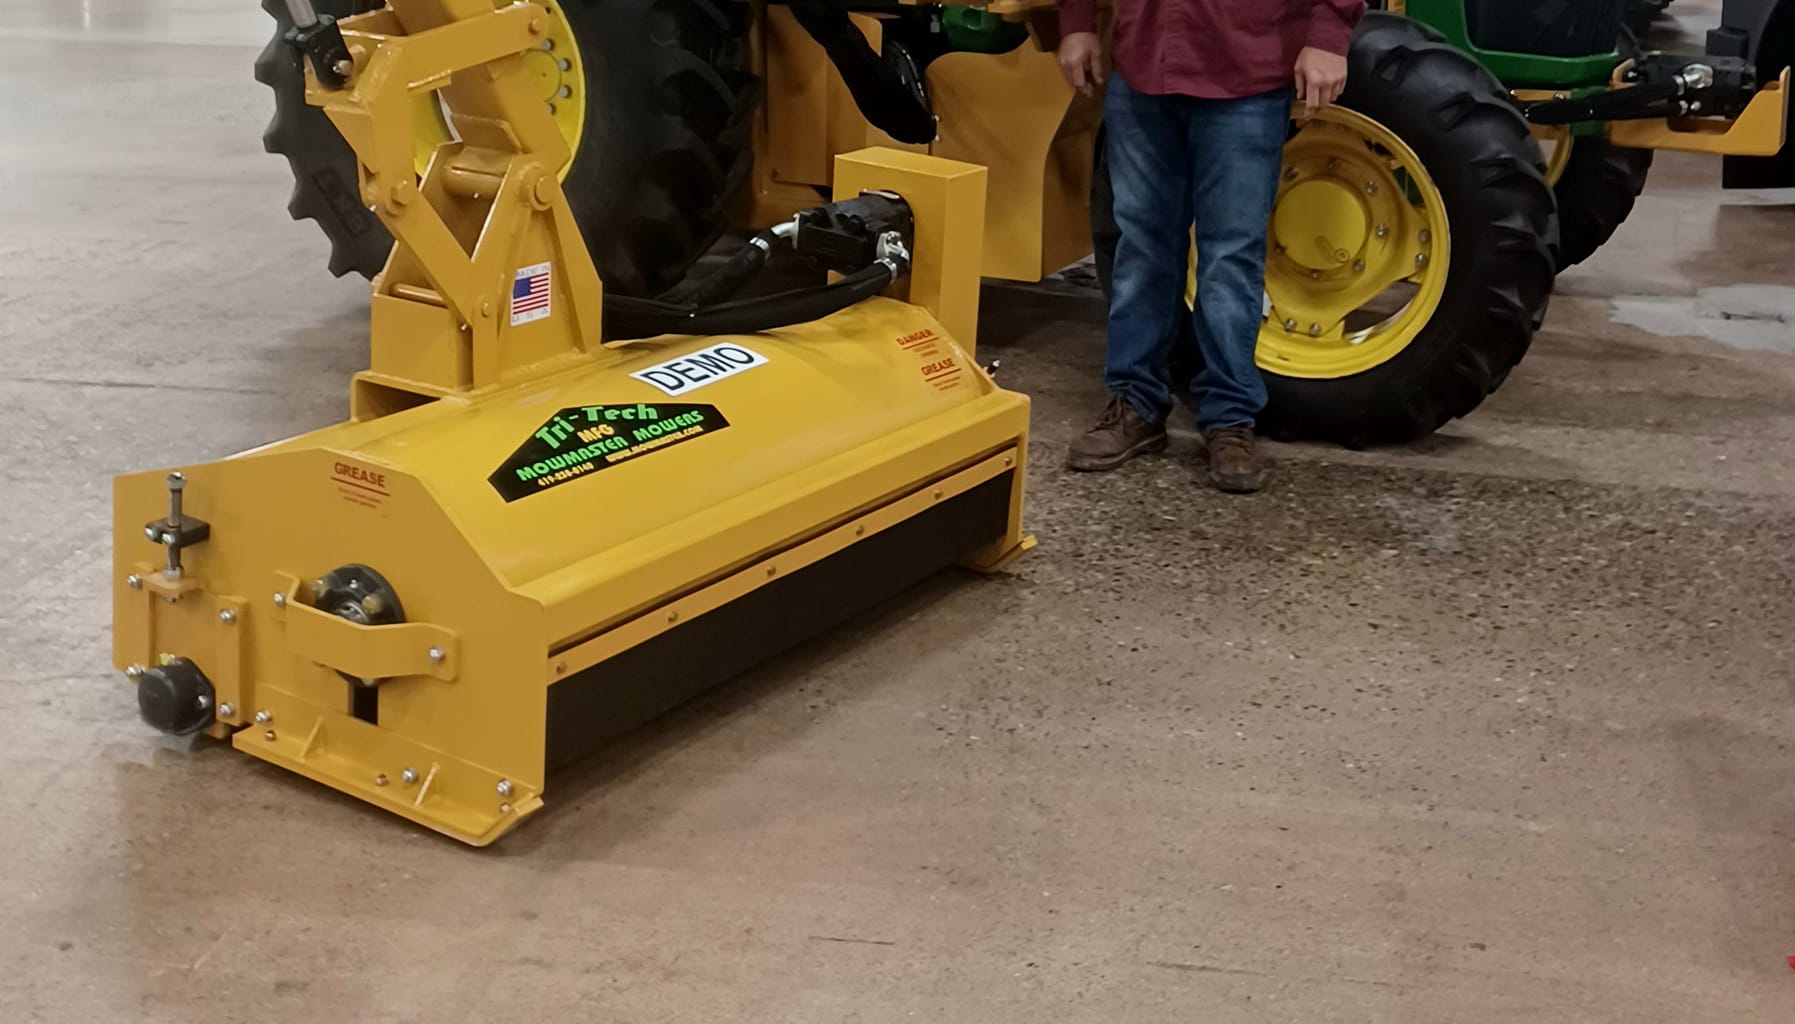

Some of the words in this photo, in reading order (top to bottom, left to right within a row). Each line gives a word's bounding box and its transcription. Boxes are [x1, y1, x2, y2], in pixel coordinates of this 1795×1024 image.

[896, 329, 934, 346] DANGER
[640, 346, 755, 391] DEMO
[921, 358, 955, 376] GREASE
[535, 404, 658, 449] Tri-Tech
[576, 424, 615, 444] MFG
[516, 436, 628, 482] MOWMASTER
[632, 410, 704, 443] MOWERS
[334, 462, 385, 488] GREASE
